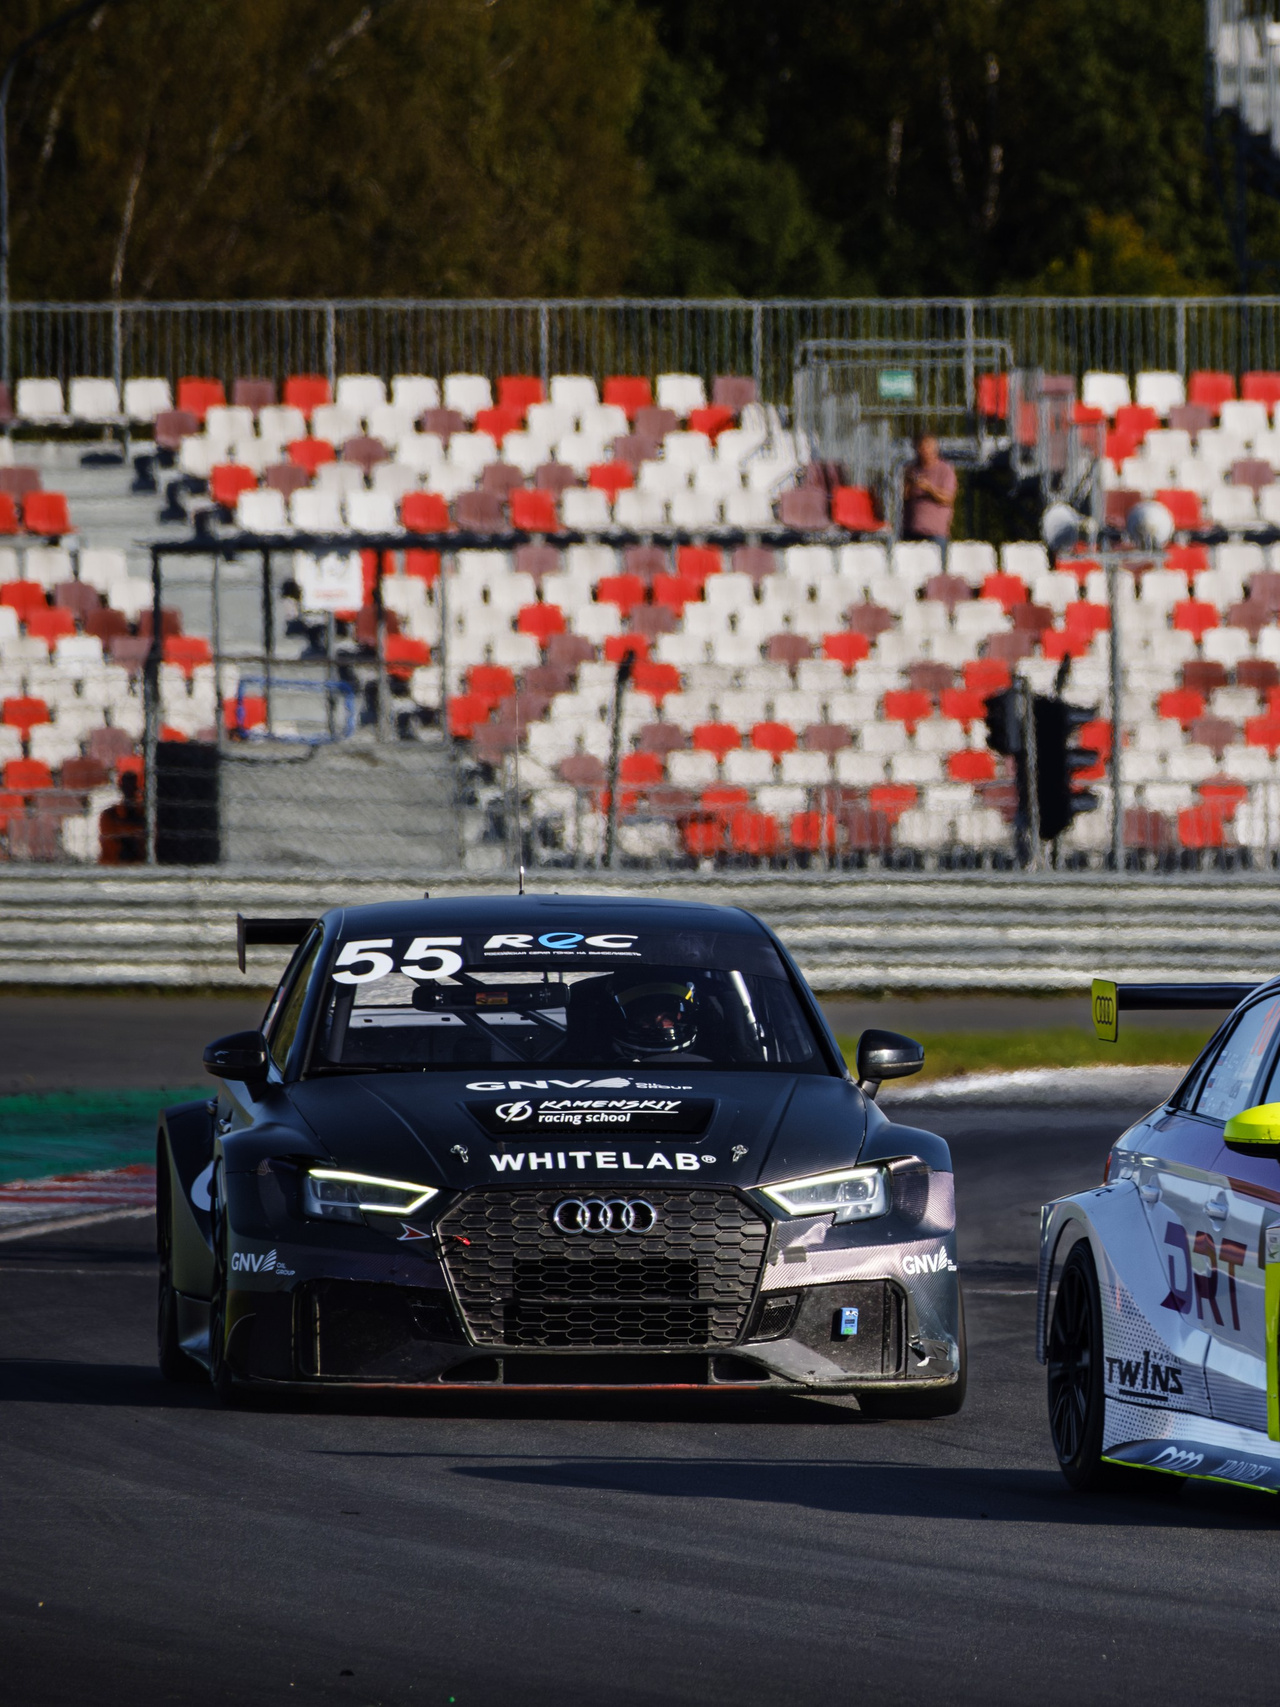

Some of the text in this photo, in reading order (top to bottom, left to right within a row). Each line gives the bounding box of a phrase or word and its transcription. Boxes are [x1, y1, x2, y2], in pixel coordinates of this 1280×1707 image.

[332, 936, 464, 985] 55
[465, 1078, 592, 1091] GNV
[538, 1099, 682, 1110] KAMENSKIY
[538, 1112, 631, 1125] racing school
[231, 1252, 265, 1272] GNV
[902, 1253, 939, 1275] GNV
[1160, 1221, 1248, 1331] DRT
[1105, 1350, 1184, 1395] TWINS
